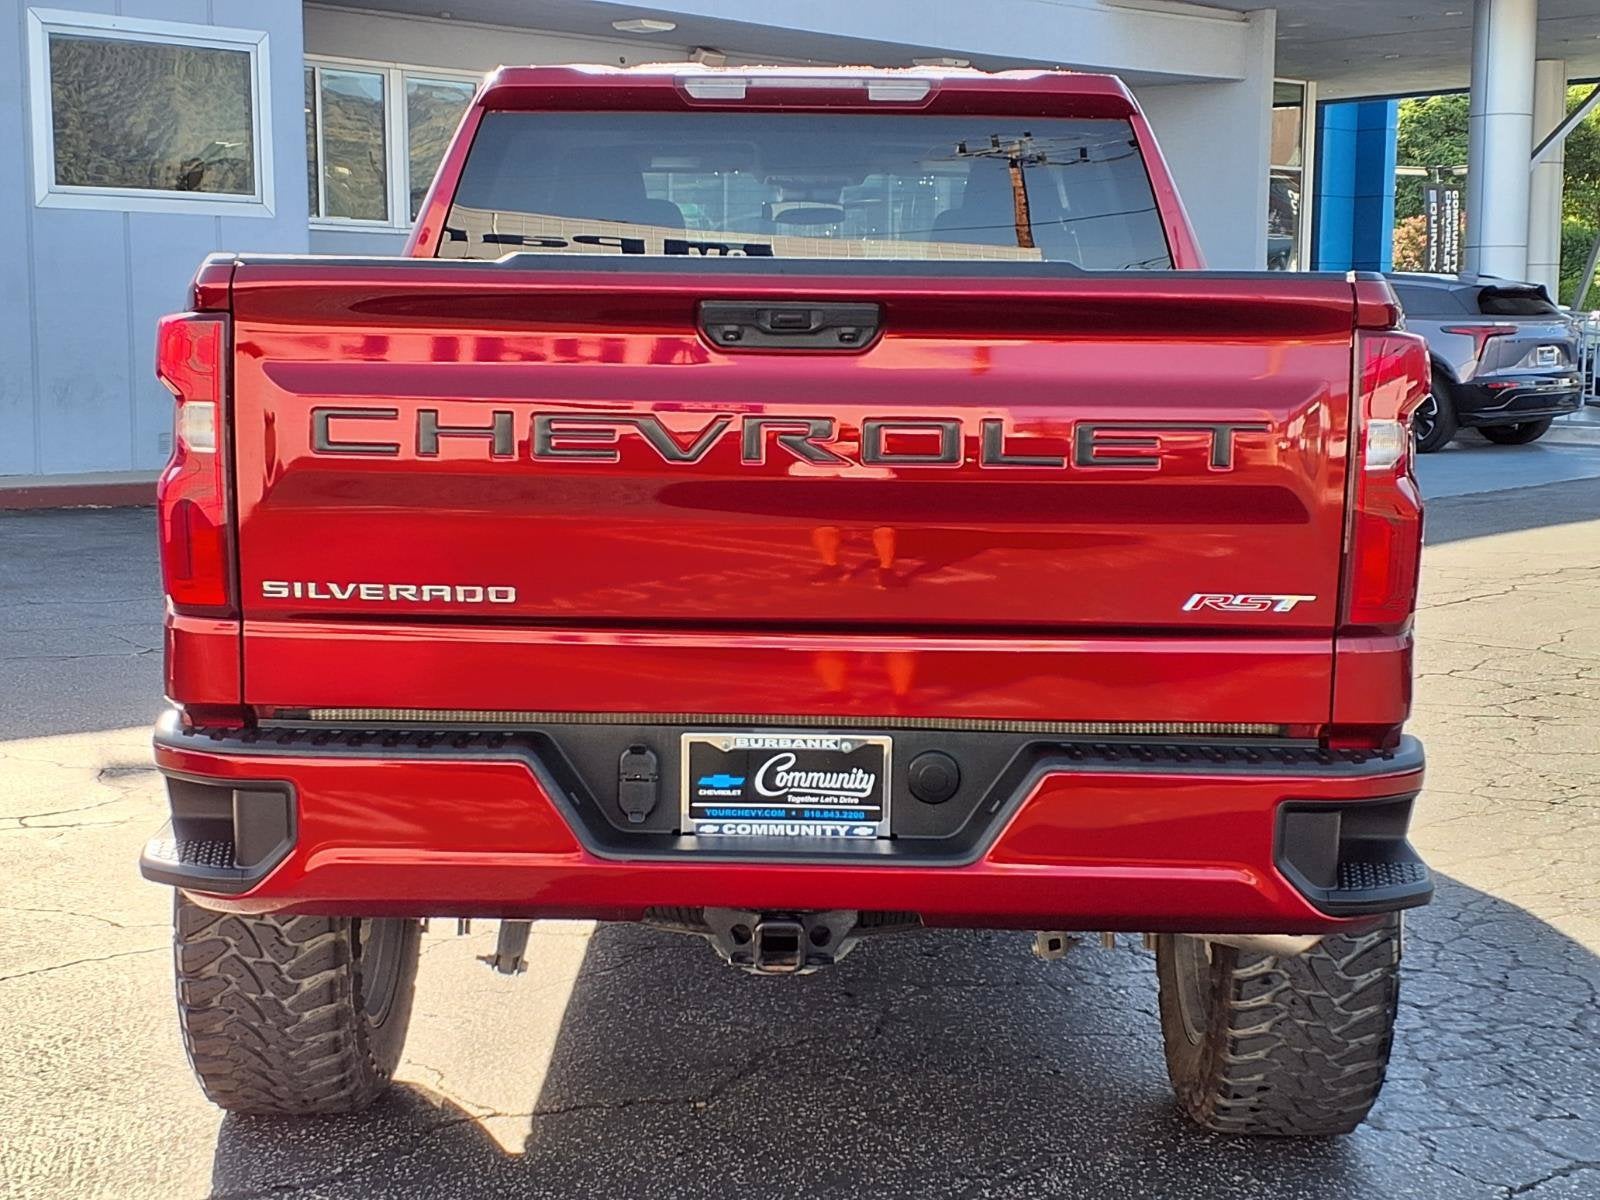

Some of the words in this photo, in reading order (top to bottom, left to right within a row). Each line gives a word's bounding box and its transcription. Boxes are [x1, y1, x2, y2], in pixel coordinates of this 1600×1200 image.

[1443, 190, 1452, 272] CHEVROLET
[1451, 189, 1459, 272] COMMUNITY
[310, 406, 1271, 471] CHEVROLET
[262, 580, 517, 603] SILVERADO
[1182, 593, 1317, 613] RST
[735, 737, 838, 749] BURBANK
[755, 752, 875, 797] Community
[787, 795, 819, 804] Together
[820, 796, 838, 804] Let's
[705, 808, 786, 817] YOURCHEVY.COM
[722, 823, 849, 836] COMMUNITY
